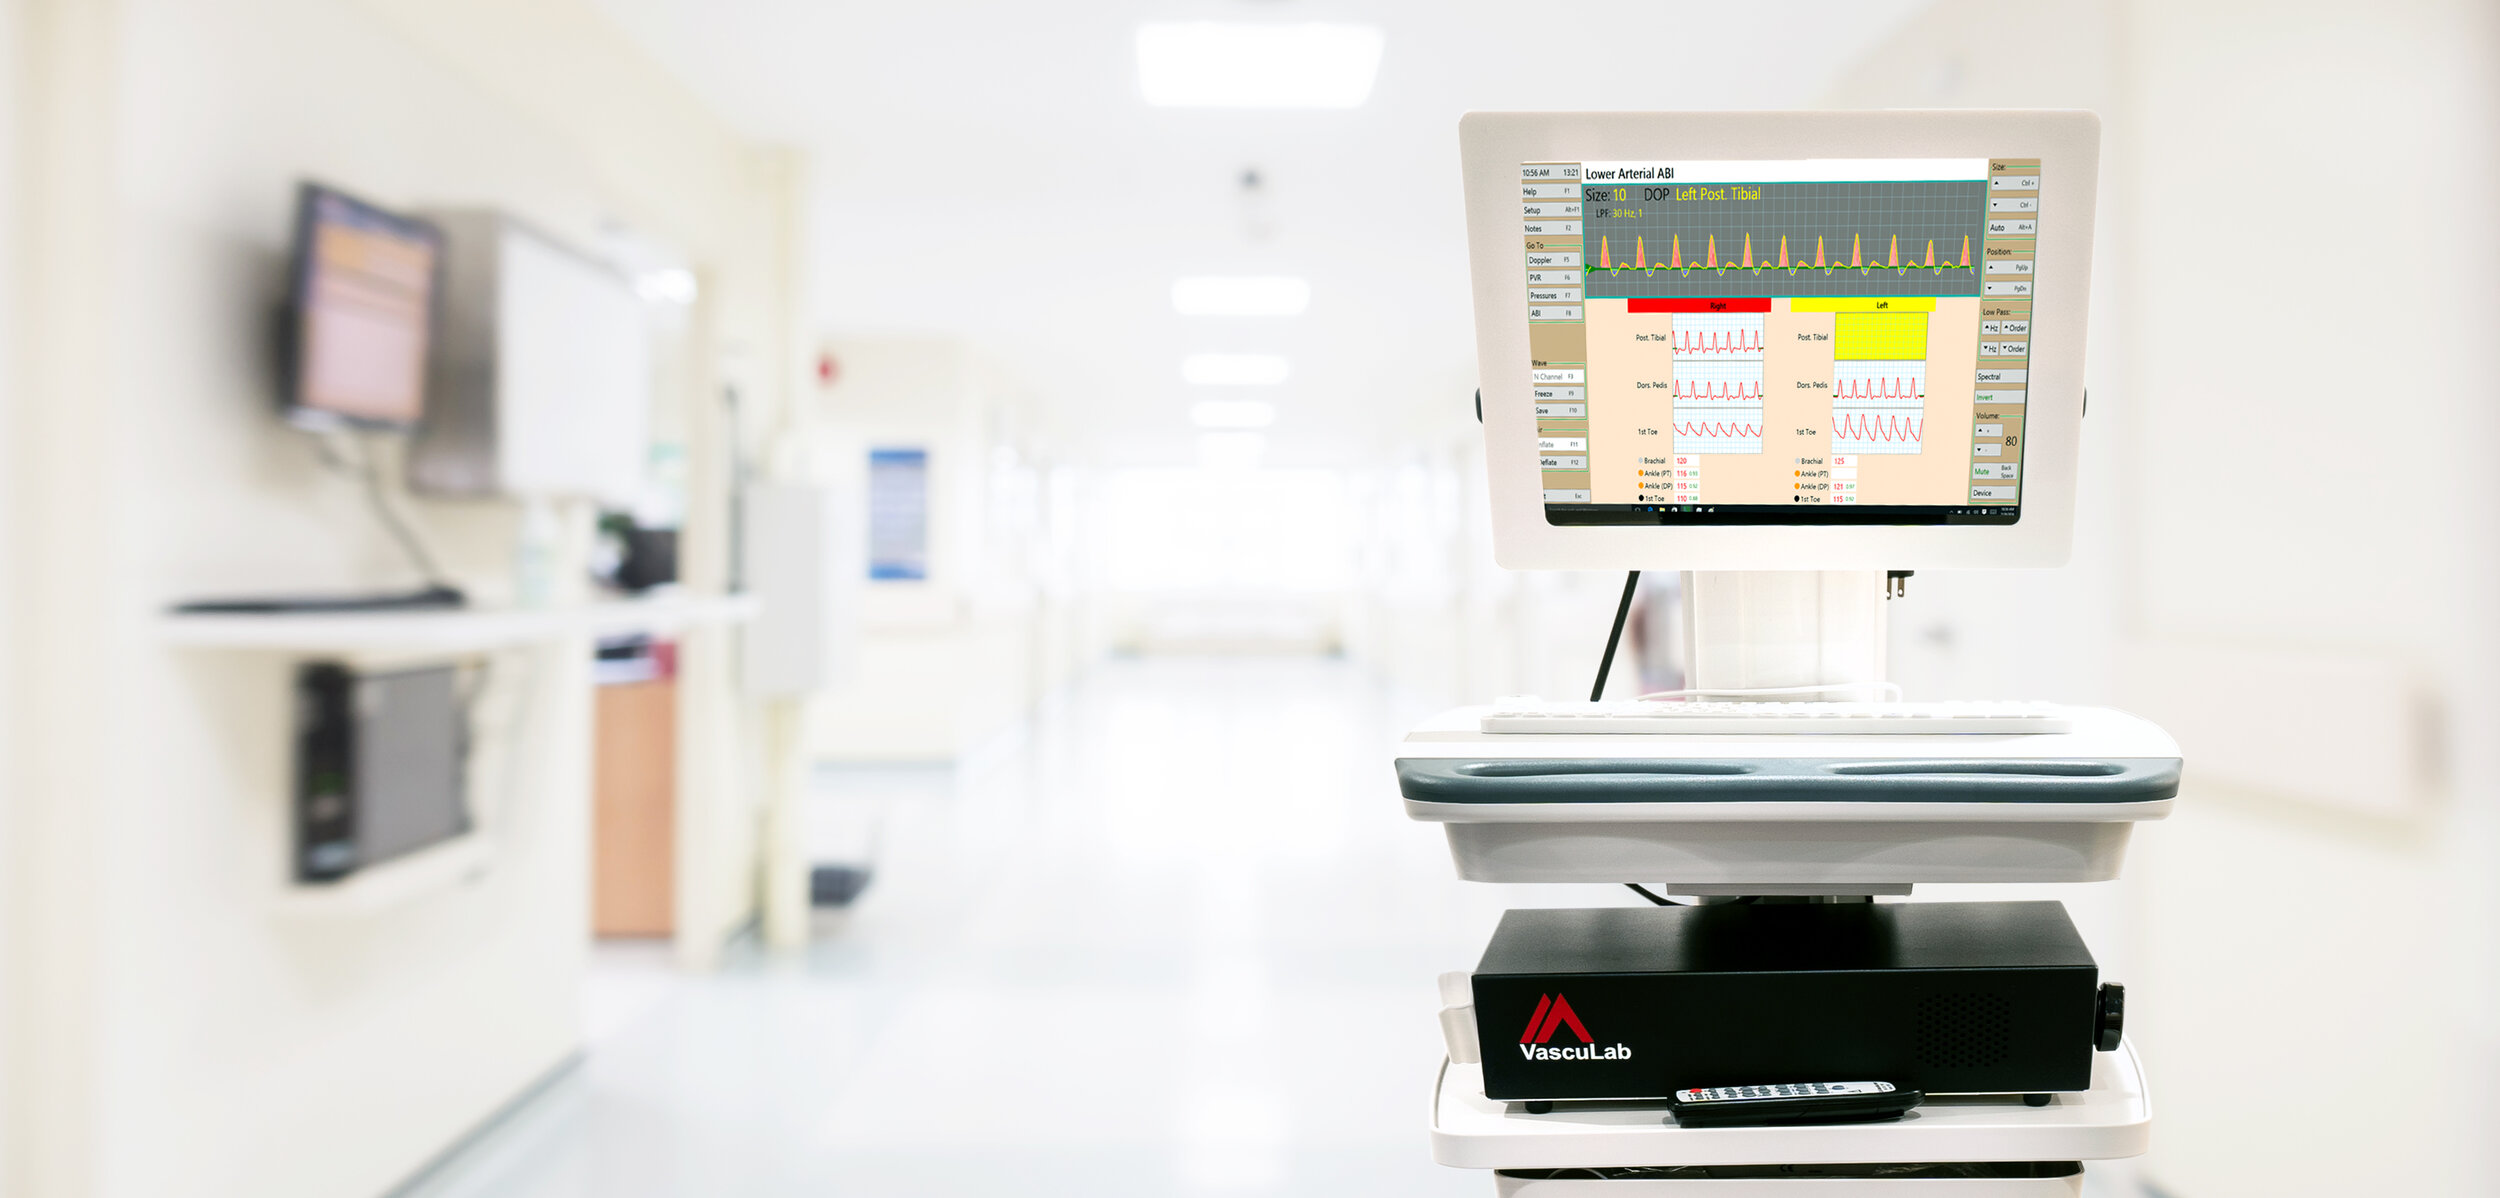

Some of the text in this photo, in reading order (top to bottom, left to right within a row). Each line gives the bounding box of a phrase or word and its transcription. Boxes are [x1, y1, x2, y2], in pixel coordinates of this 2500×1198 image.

[1992, 163, 2006, 171] Size:
[1585, 167, 1674, 179] Lower Arterial ABI
[1523, 188, 1537, 197] Help
[1586, 186, 1761, 202] Size: 10 DOP Left Post. Tibial
[1524, 207, 1541, 215] Setup
[1596, 209, 1611, 218] LPF:
[1612, 209, 1622, 218] 30
[1638, 209, 1642, 217] 1
[1987, 248, 2012, 256] Position:
[1529, 256, 1552, 265] Doppler
[1710, 302, 1726, 311] Right
[1876, 301, 1888, 309] Left
[1531, 309, 1541, 317] ABI
[2010, 324, 2027, 332] Order
[1798, 333, 1828, 341] Post. Tibial
[1978, 373, 2001, 381] Spectral
[1653, 381, 1667, 389] Pedis
[1813, 381, 1828, 389] Pedis
[2005, 436, 2018, 446] 80
[1818, 483, 1829, 491] (DP)
[1973, 489, 1992, 497] Device
[1519, 1043, 1632, 1060] VascuLab
